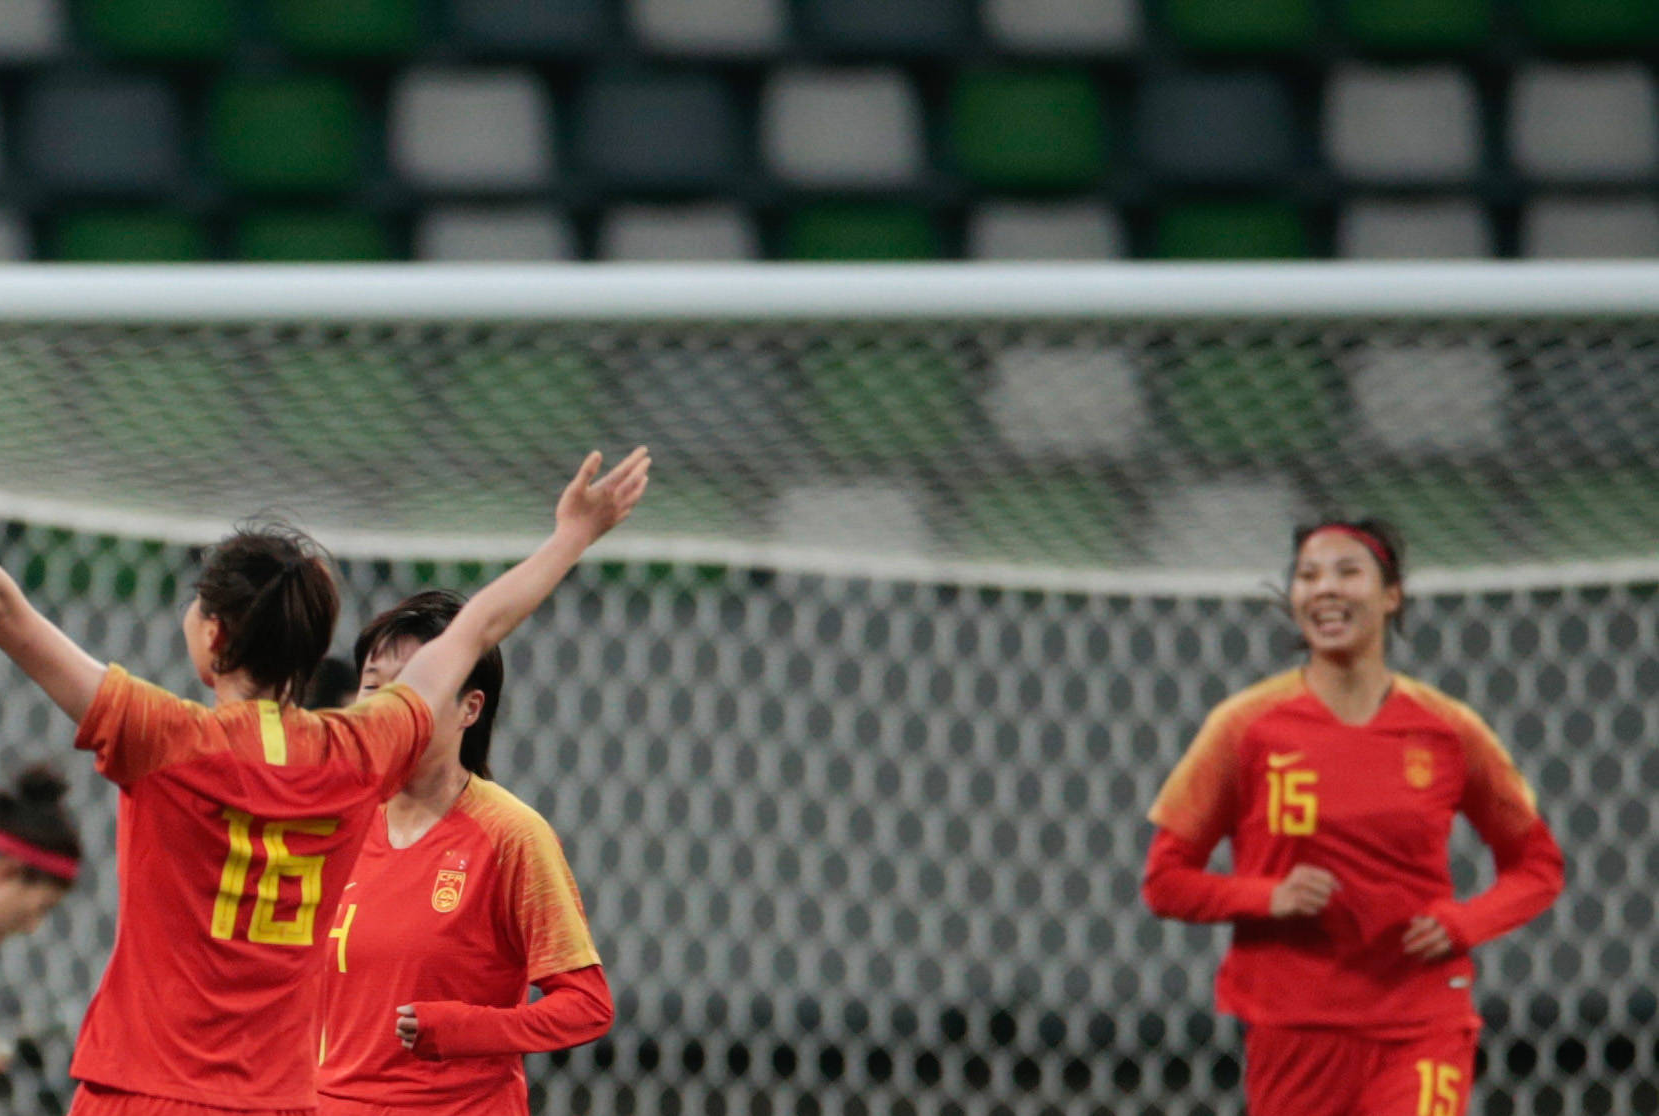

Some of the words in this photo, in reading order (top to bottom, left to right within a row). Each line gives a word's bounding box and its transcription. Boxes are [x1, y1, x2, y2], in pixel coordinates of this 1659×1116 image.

[1267, 769, 1318, 837] 15
[210, 809, 339, 945] 16
[328, 903, 357, 974] 4
